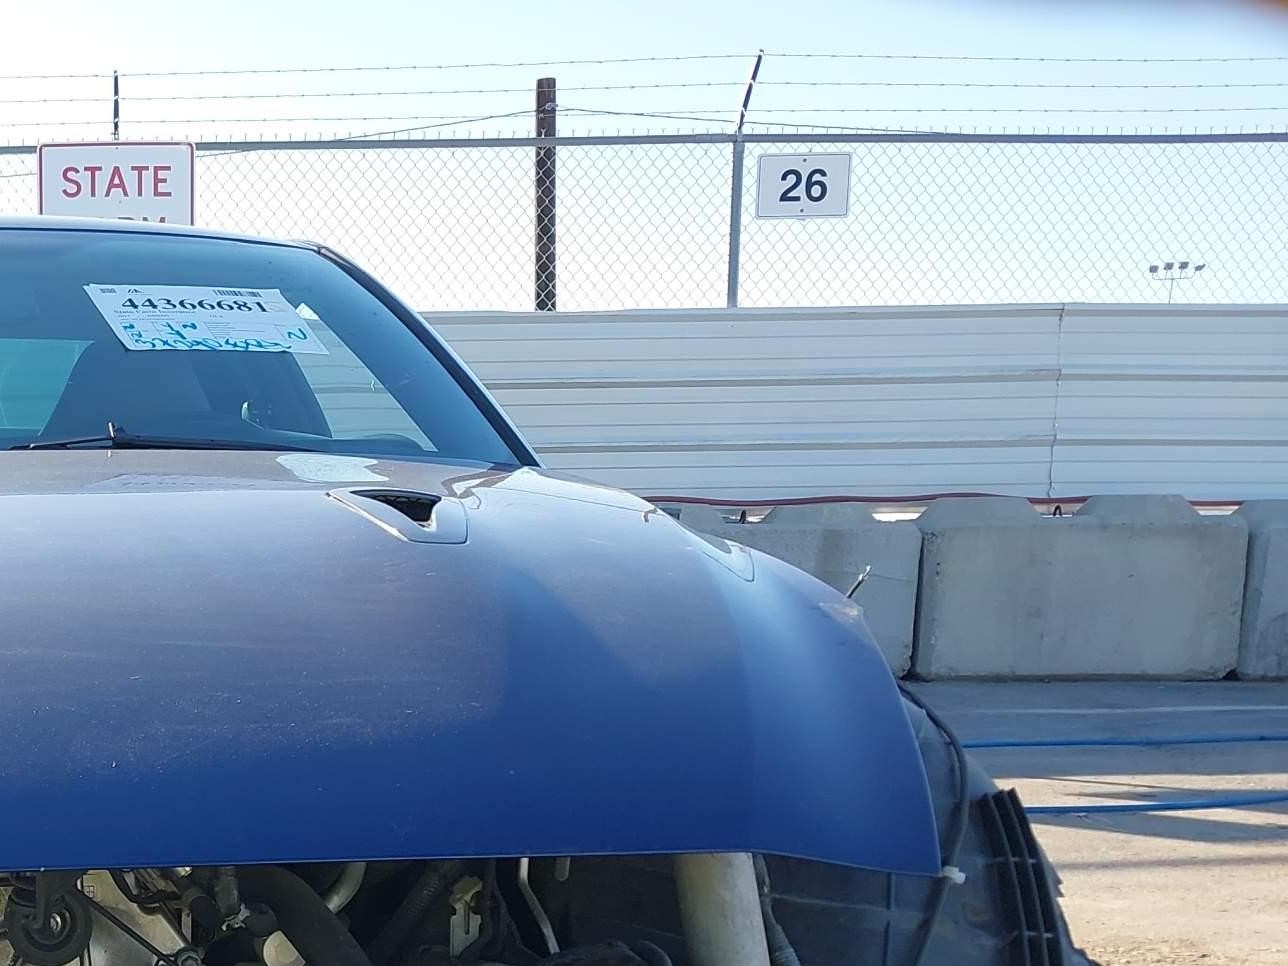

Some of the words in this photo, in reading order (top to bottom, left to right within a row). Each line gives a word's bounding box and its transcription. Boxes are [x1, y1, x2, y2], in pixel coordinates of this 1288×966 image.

[62, 165, 173, 199] STATE
[779, 168, 828, 203] 26
[121, 298, 269, 312] 44366681
